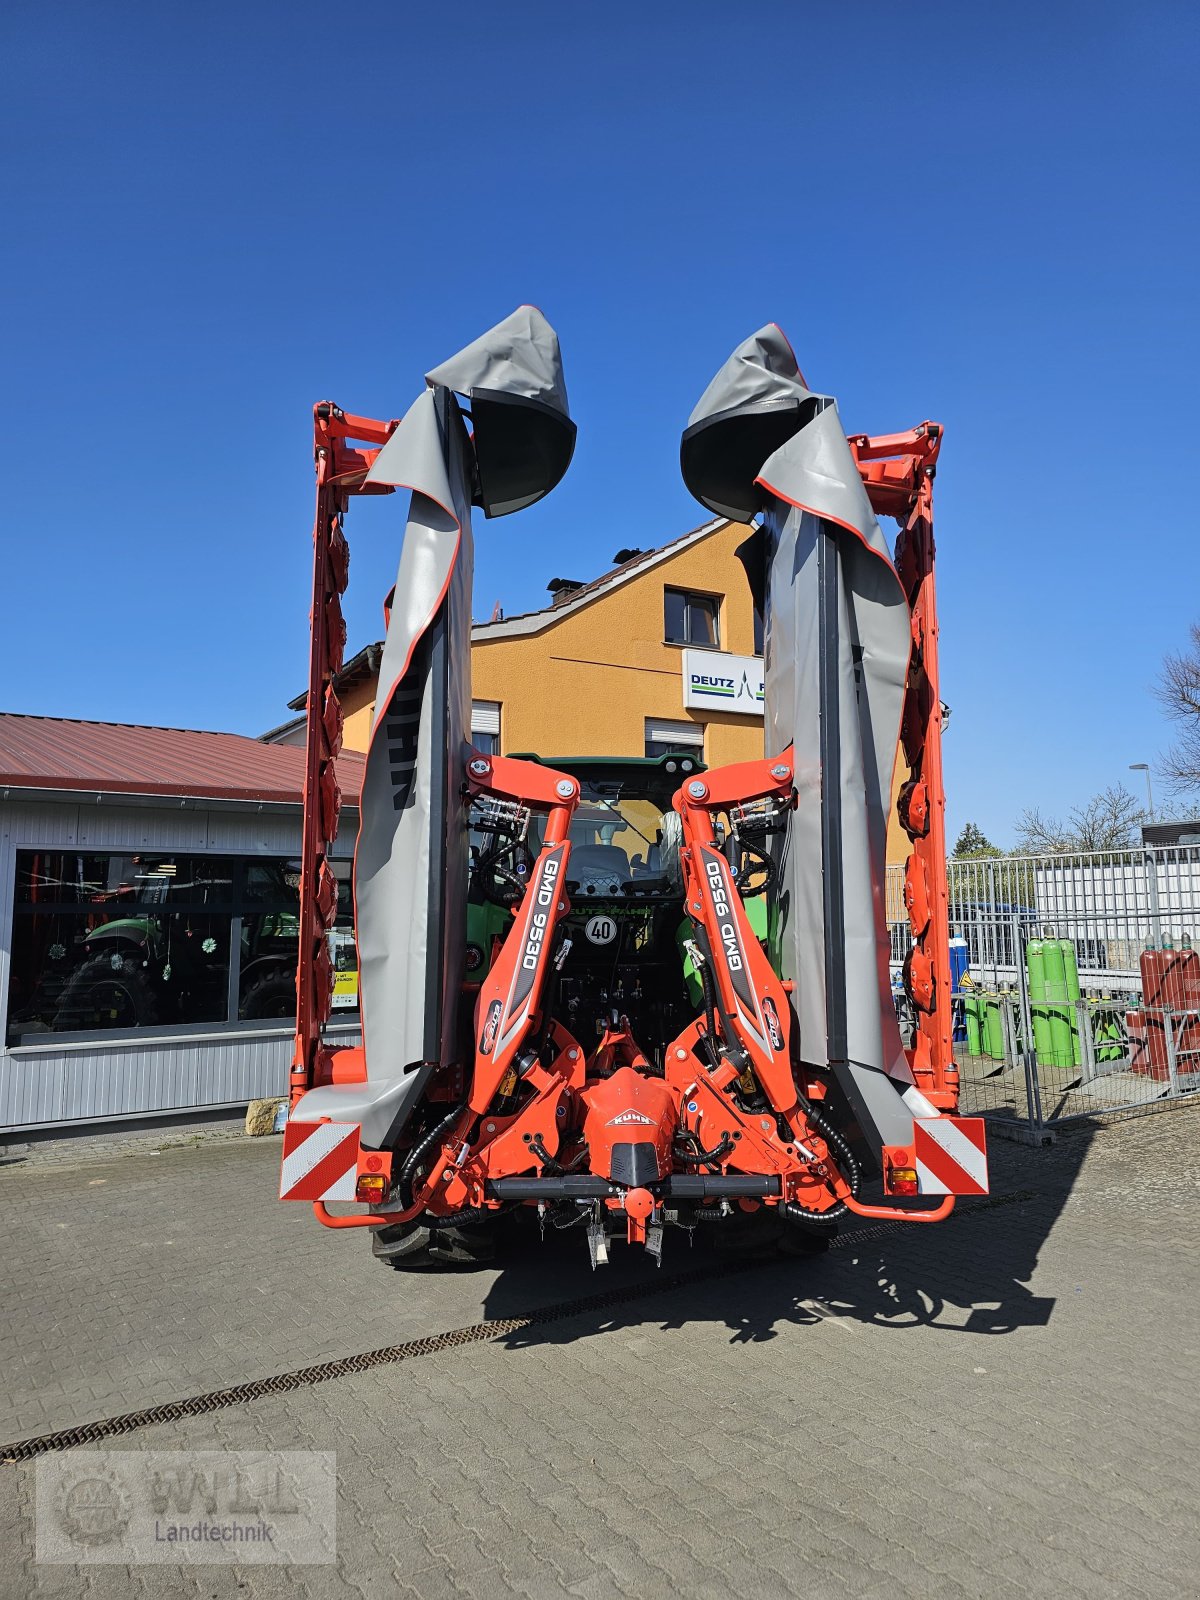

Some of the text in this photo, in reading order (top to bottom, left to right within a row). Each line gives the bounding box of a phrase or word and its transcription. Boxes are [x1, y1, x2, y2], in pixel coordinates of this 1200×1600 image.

[691, 674, 734, 688] DEUTZ
[523, 860, 559, 970] GMD 9530
[706, 861, 742, 971] GMD 9530
[591, 921, 611, 940] 40
[614, 1113, 650, 1124] KUHN
